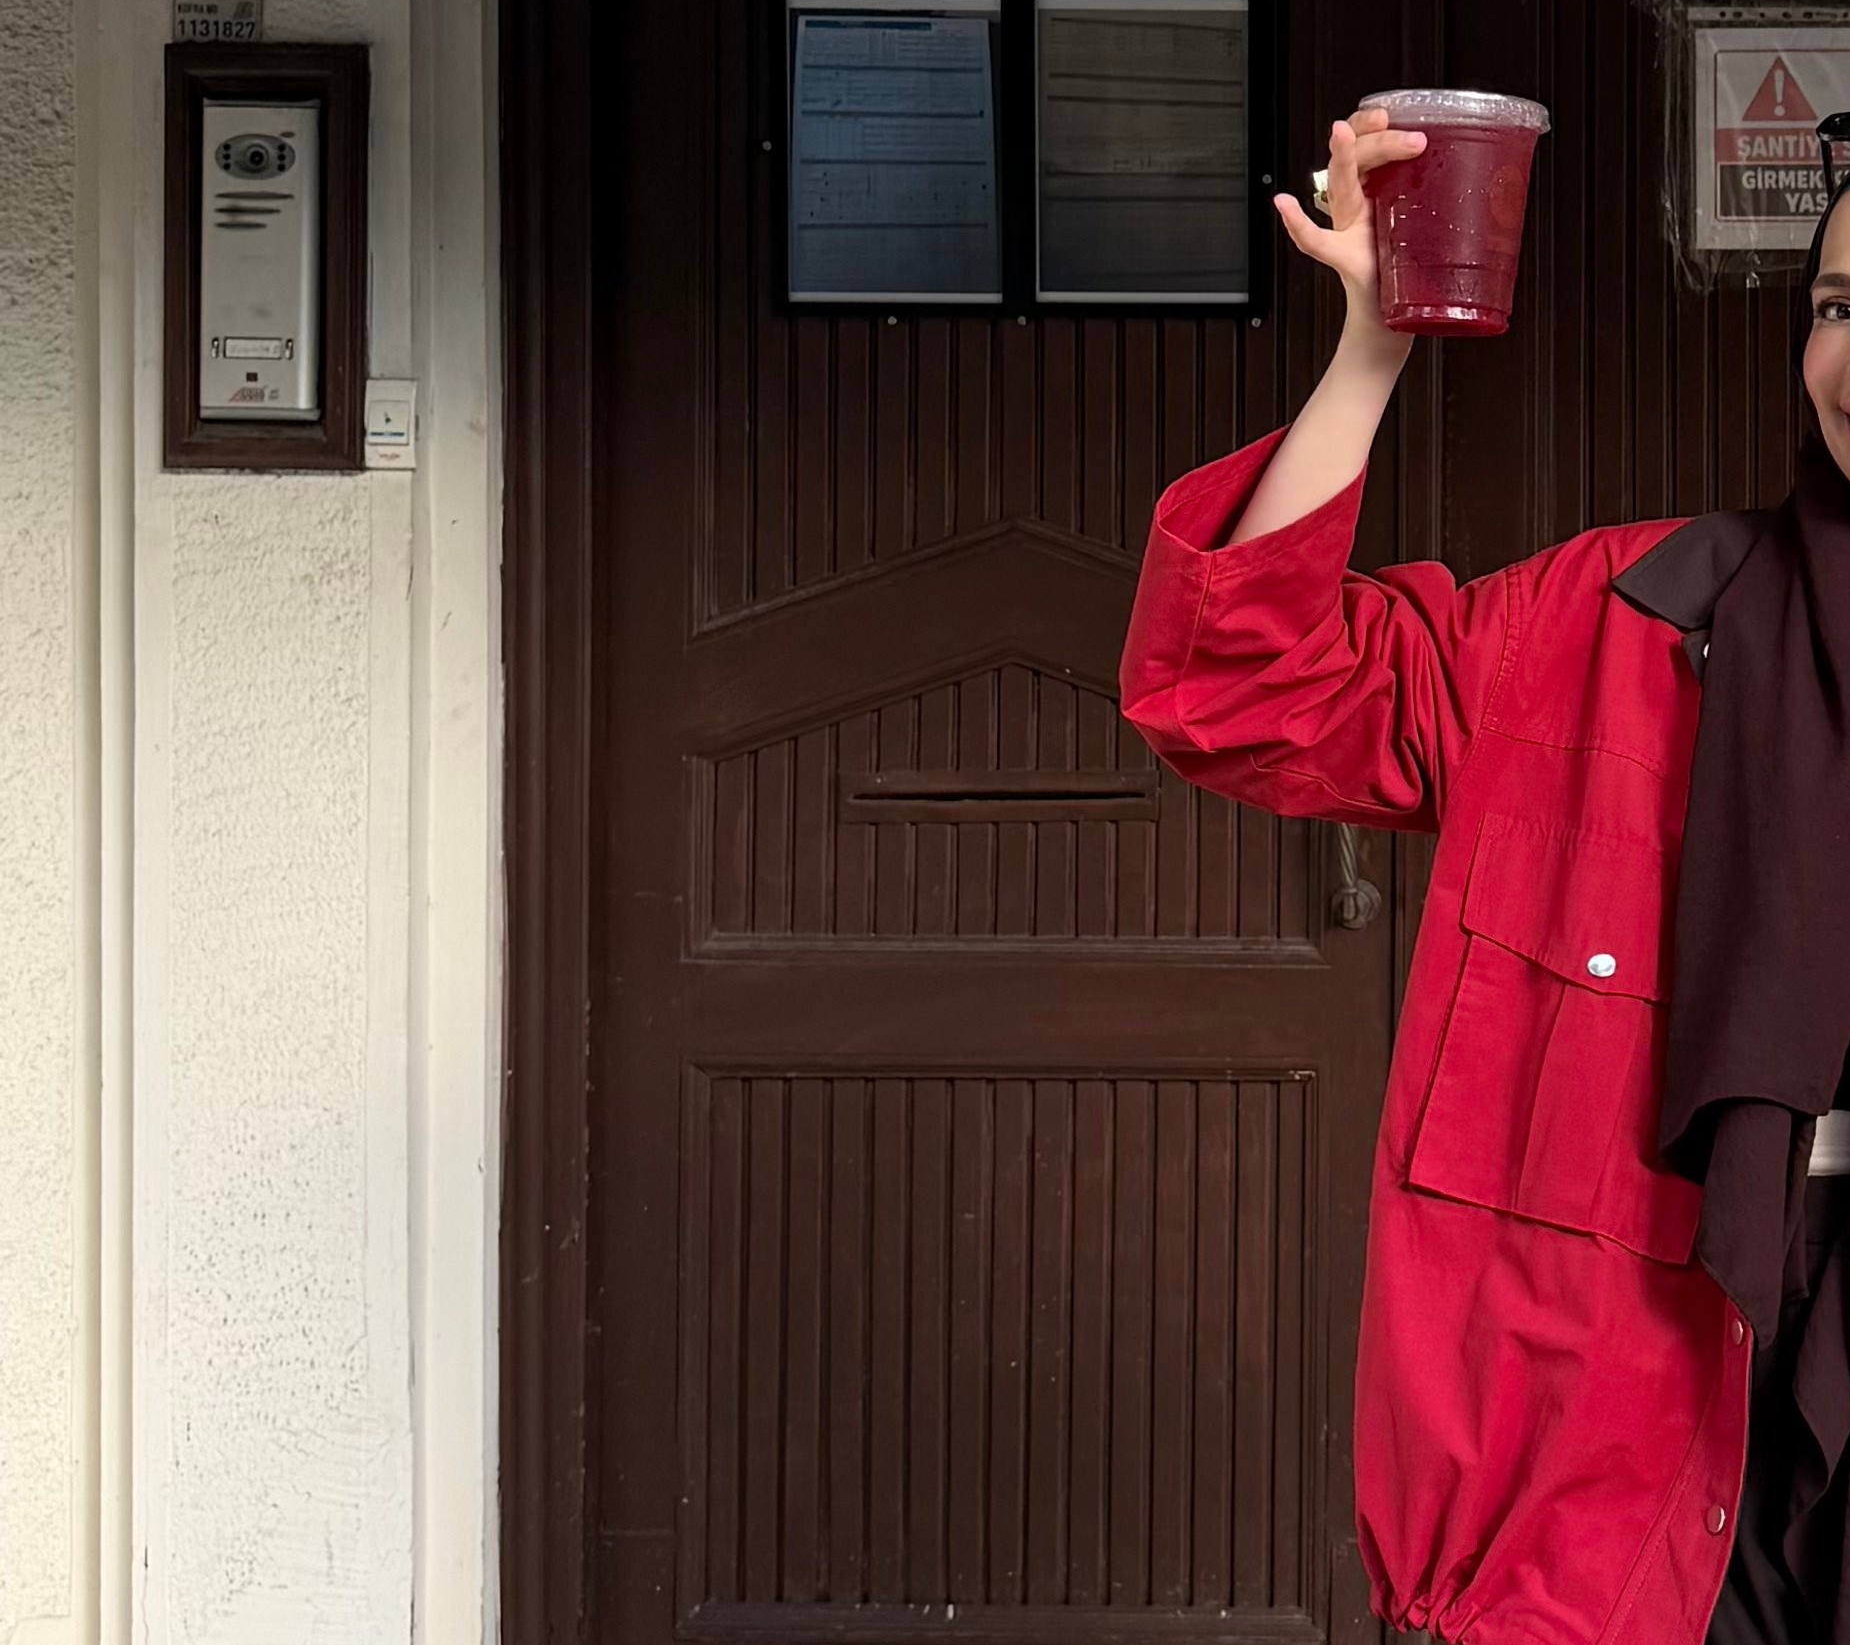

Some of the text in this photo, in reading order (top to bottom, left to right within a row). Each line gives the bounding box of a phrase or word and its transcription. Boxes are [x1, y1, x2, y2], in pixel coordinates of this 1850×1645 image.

[178, 19, 255, 39] 1131827
[1737, 132, 1834, 162] ŞANTİY
[1742, 167, 1824, 189] GİRMEK
[1785, 192, 1828, 213] YAS
